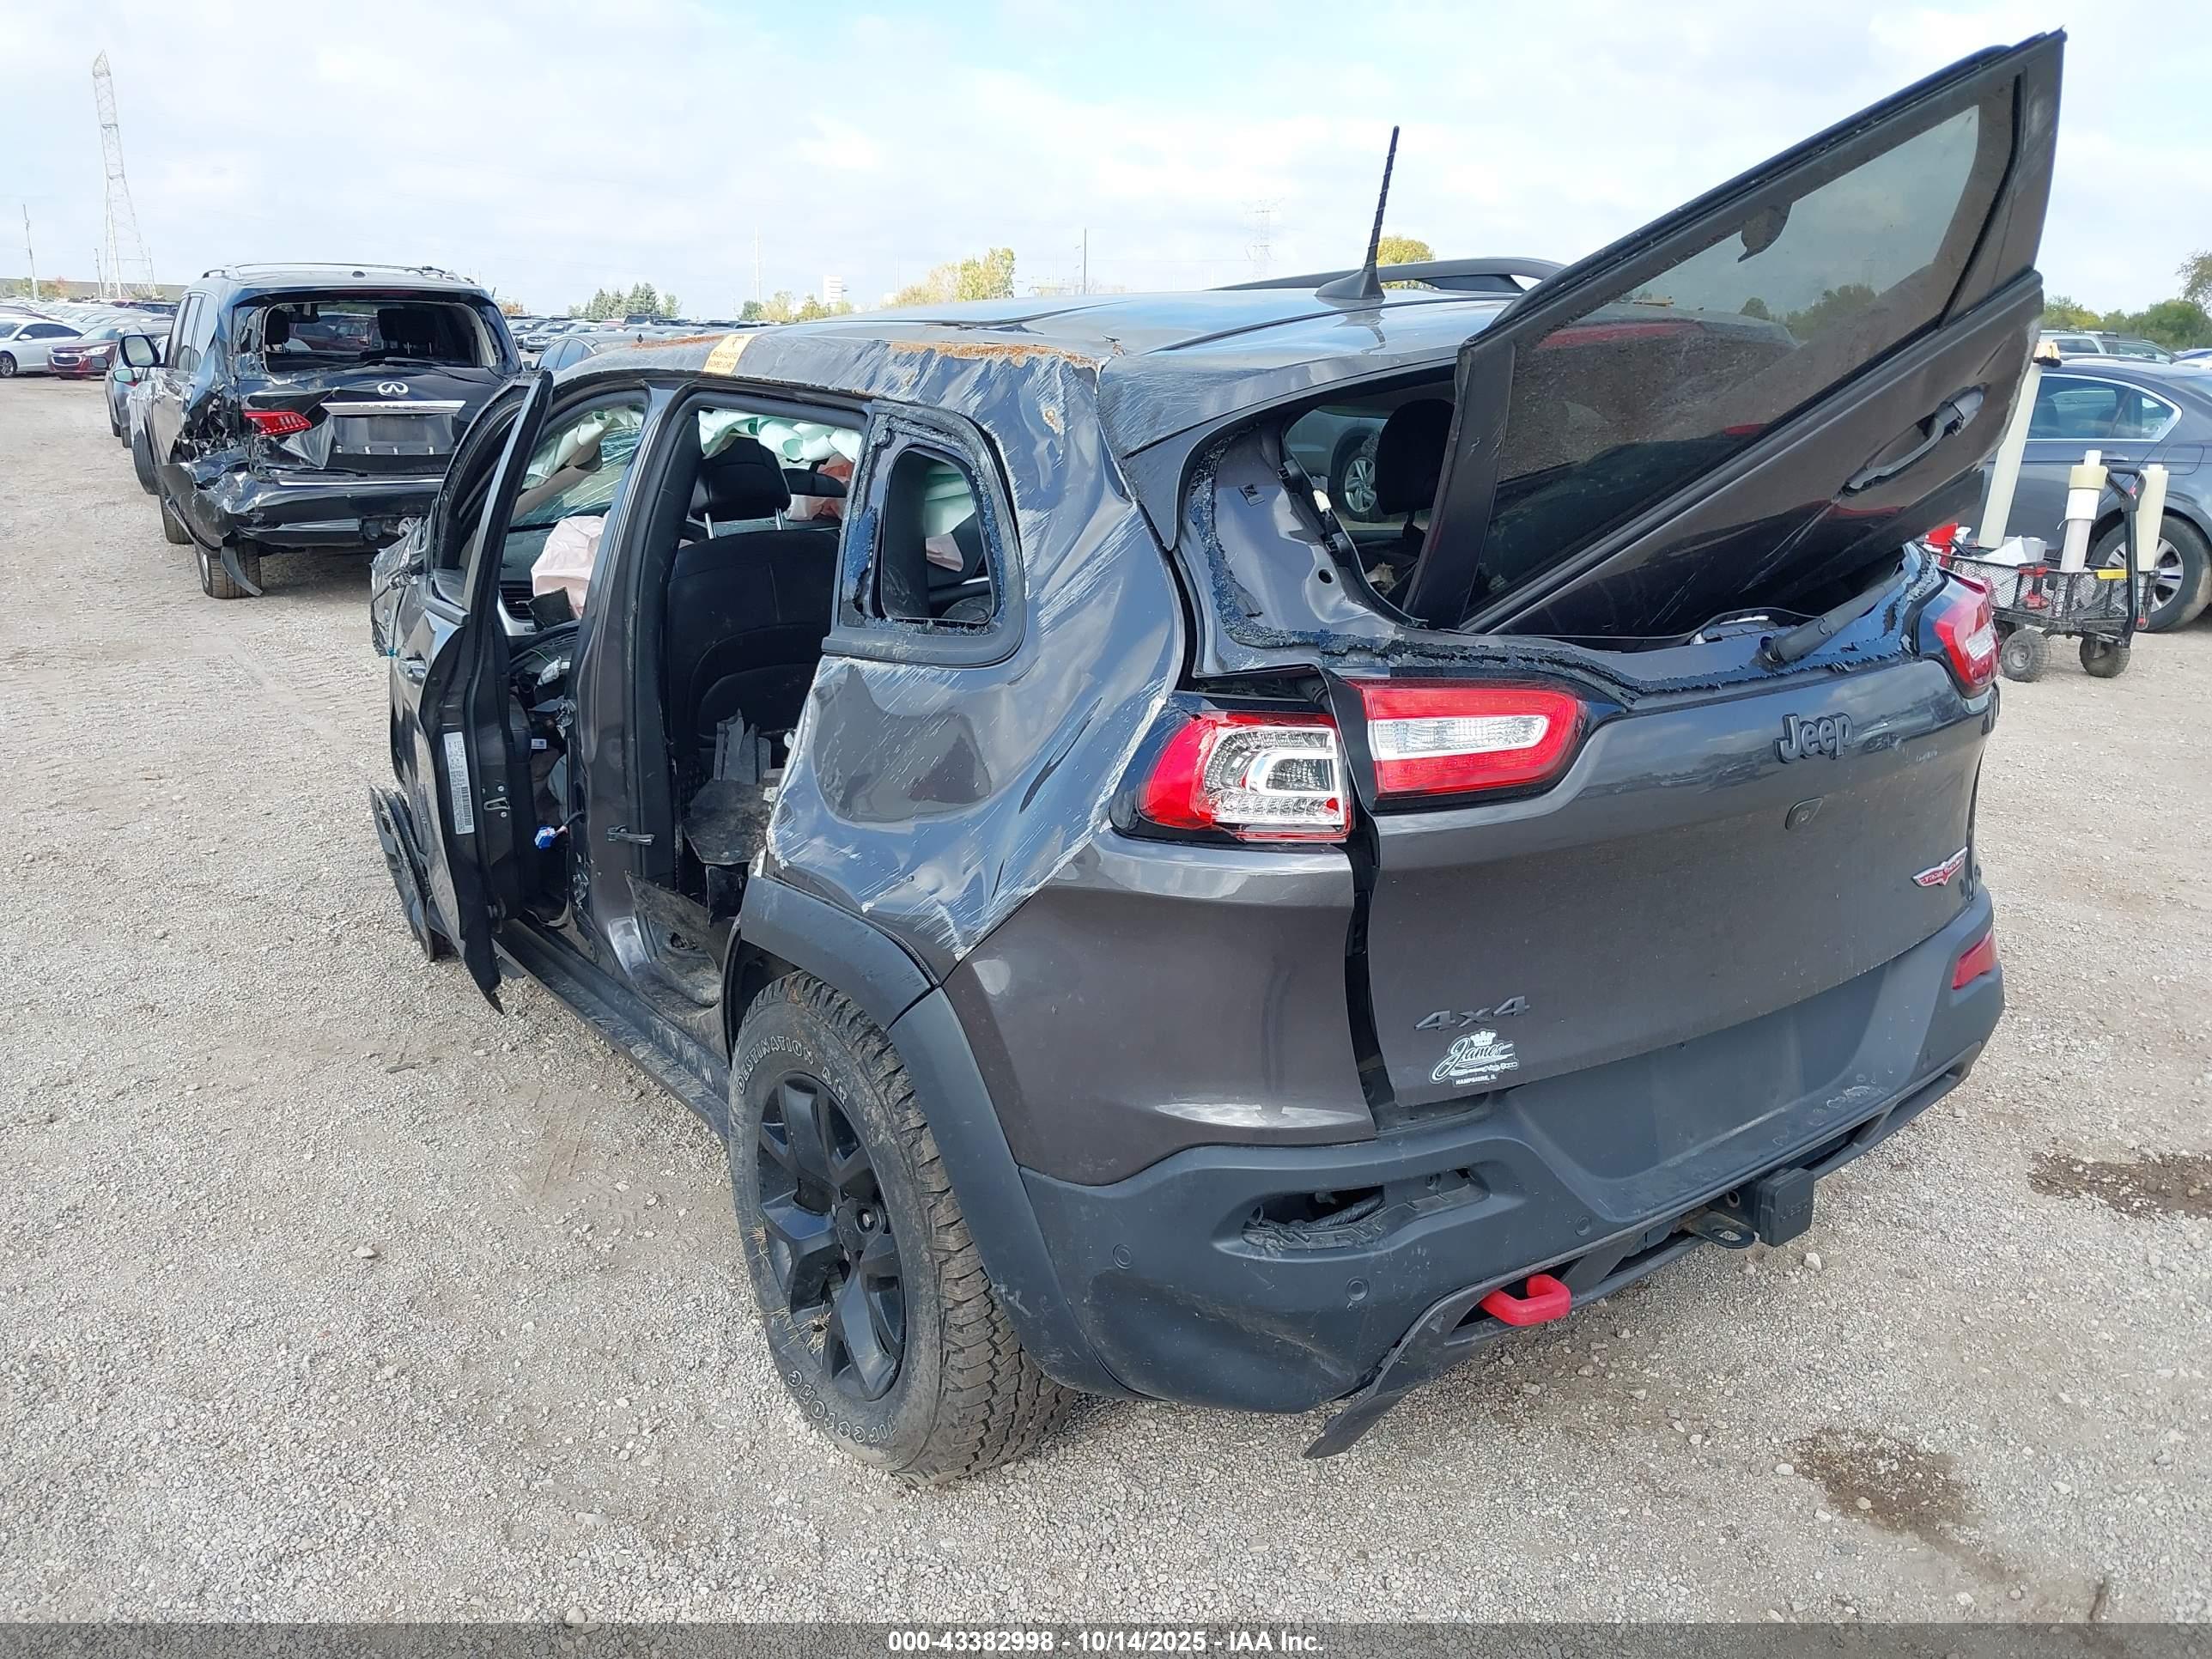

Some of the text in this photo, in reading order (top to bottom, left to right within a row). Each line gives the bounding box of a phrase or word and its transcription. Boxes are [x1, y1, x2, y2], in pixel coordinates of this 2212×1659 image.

[1773, 713, 1853, 763] Jeep
[1414, 995, 1530, 1030] 4x4
[737, 1036, 815, 1095] DESTINATION
[1431, 1036, 1514, 1081] James
